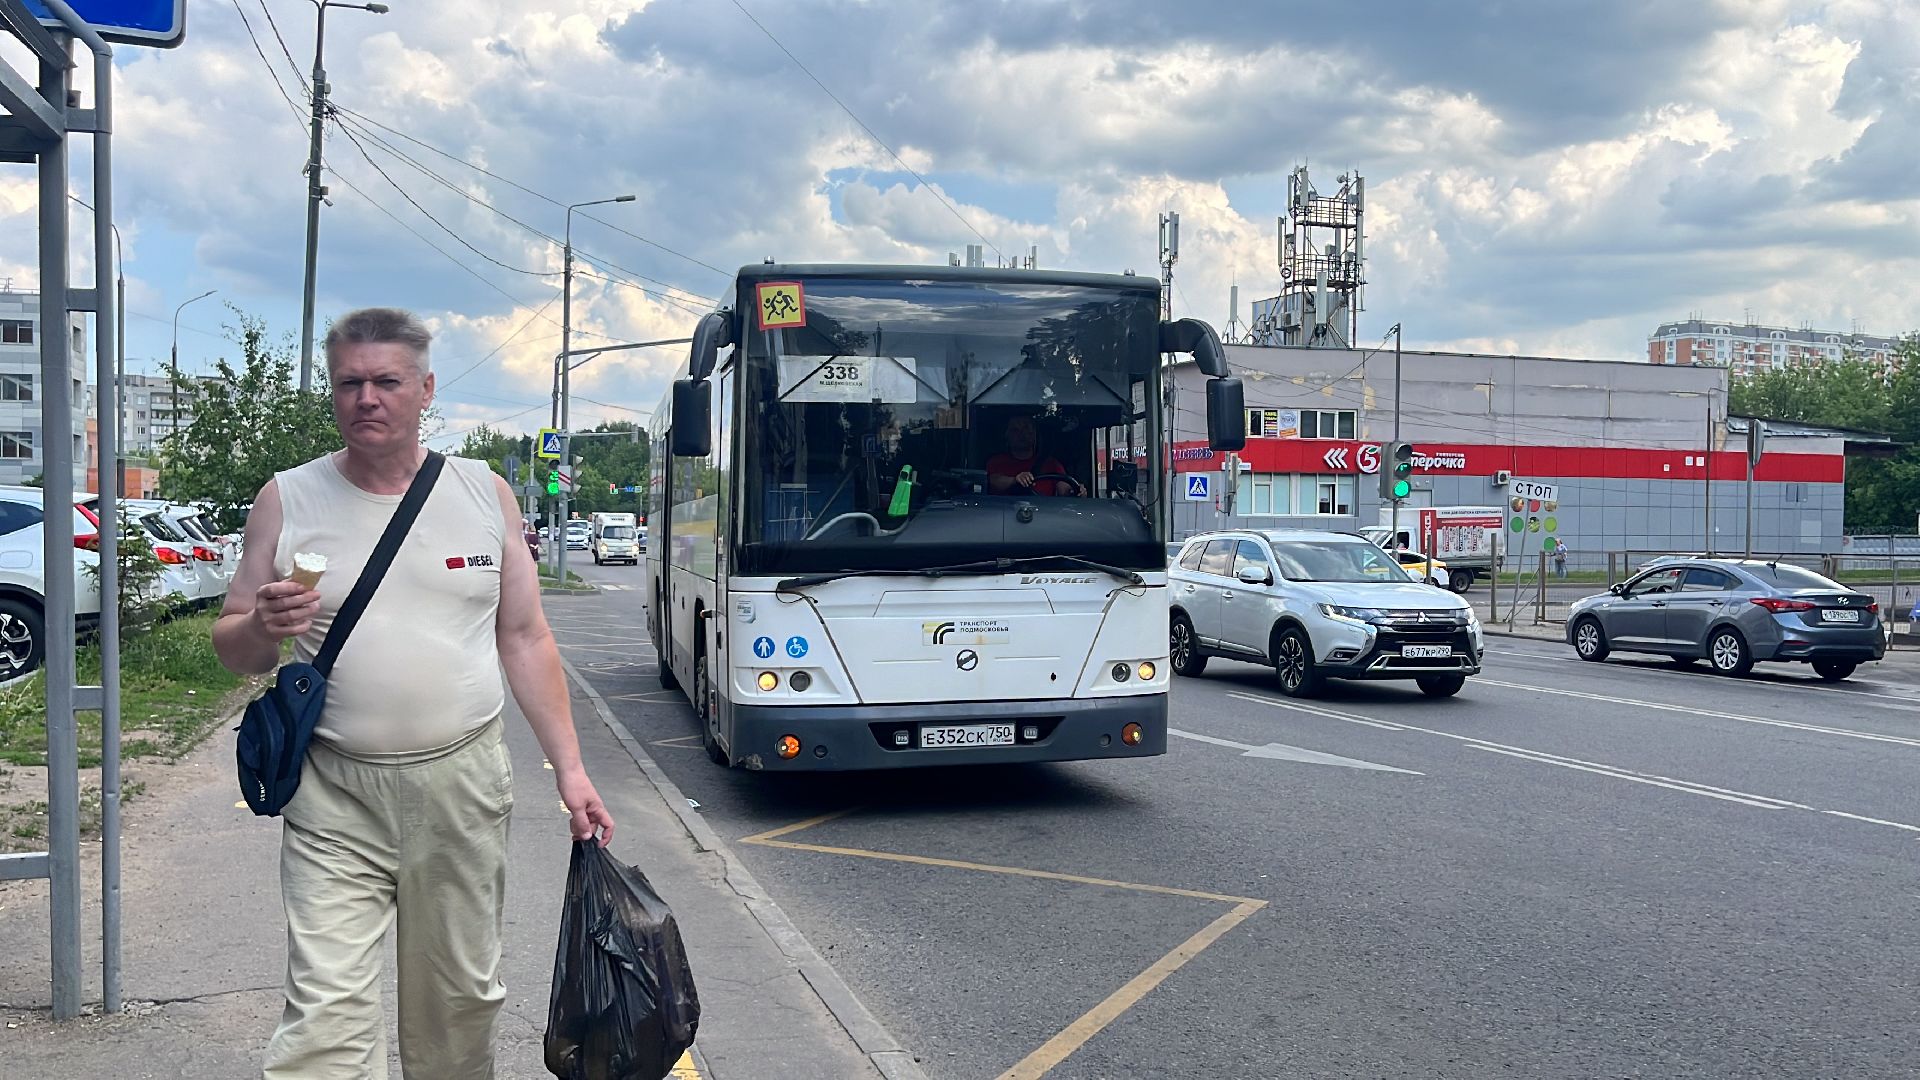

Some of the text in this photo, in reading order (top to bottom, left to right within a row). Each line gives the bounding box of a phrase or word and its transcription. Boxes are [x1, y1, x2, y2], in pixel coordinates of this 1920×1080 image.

[823, 365, 859, 380] 338
[1515, 482, 1552, 499] СТОП
[467, 555, 493, 566] DIESEL
[1020, 576, 1098, 585] VOYAGE
[988, 726, 1011, 738] 750
